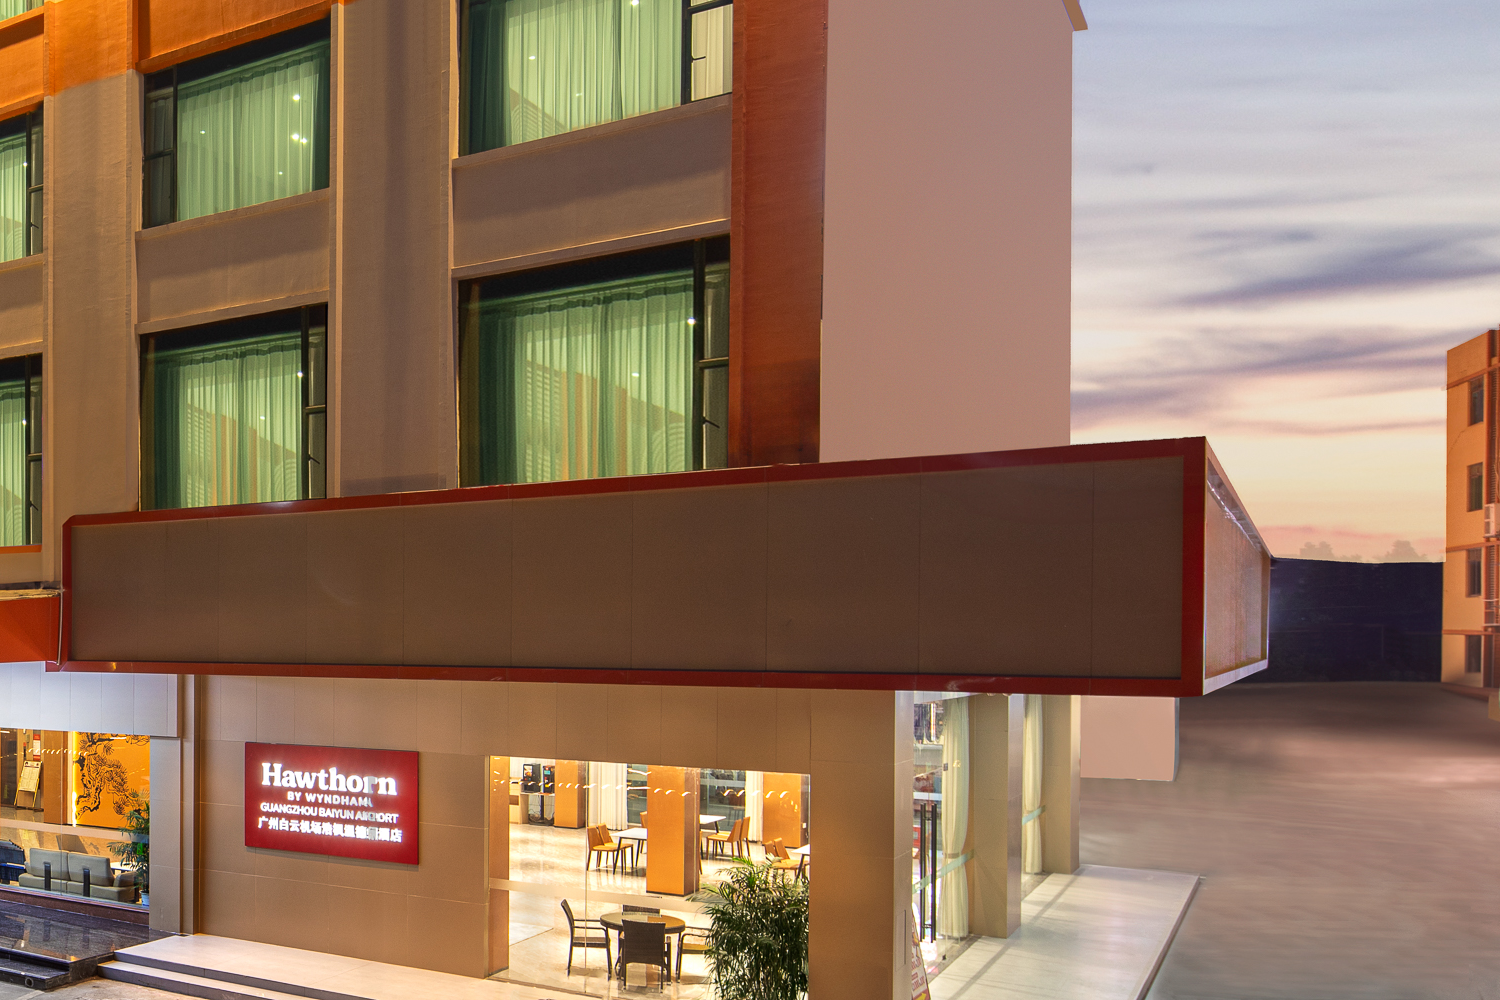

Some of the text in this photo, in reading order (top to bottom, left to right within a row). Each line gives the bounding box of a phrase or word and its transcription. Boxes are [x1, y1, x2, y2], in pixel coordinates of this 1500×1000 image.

[261, 762, 398, 796] Hawthorn
[287, 791, 373, 807] BY WYNDHAM
[260, 802, 318, 816] GUANGZHOU
[319, 807, 354, 820] BAIYUN
